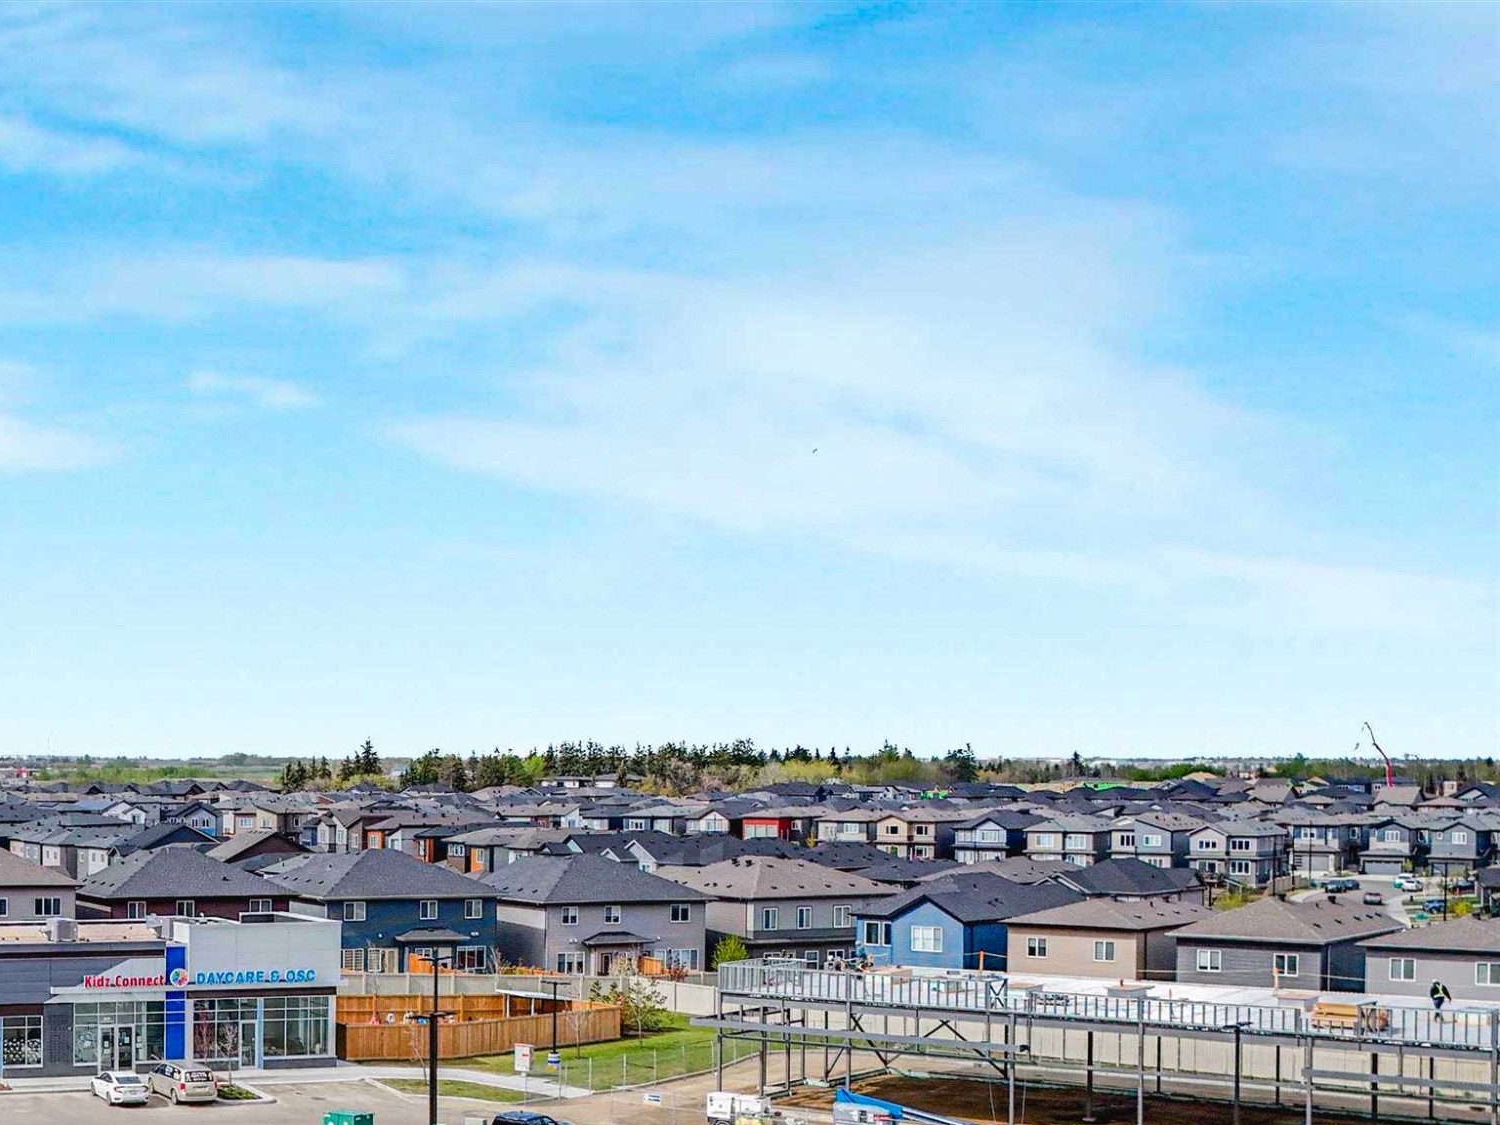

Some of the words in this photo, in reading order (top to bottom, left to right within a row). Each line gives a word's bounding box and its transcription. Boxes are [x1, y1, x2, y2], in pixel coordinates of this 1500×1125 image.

[84, 973, 111, 989] Kidz
[114, 973, 164, 988] Connect
[196, 970, 265, 986] DAYCARE
[268, 969, 281, 983] &
[285, 968, 316, 983] OSC
